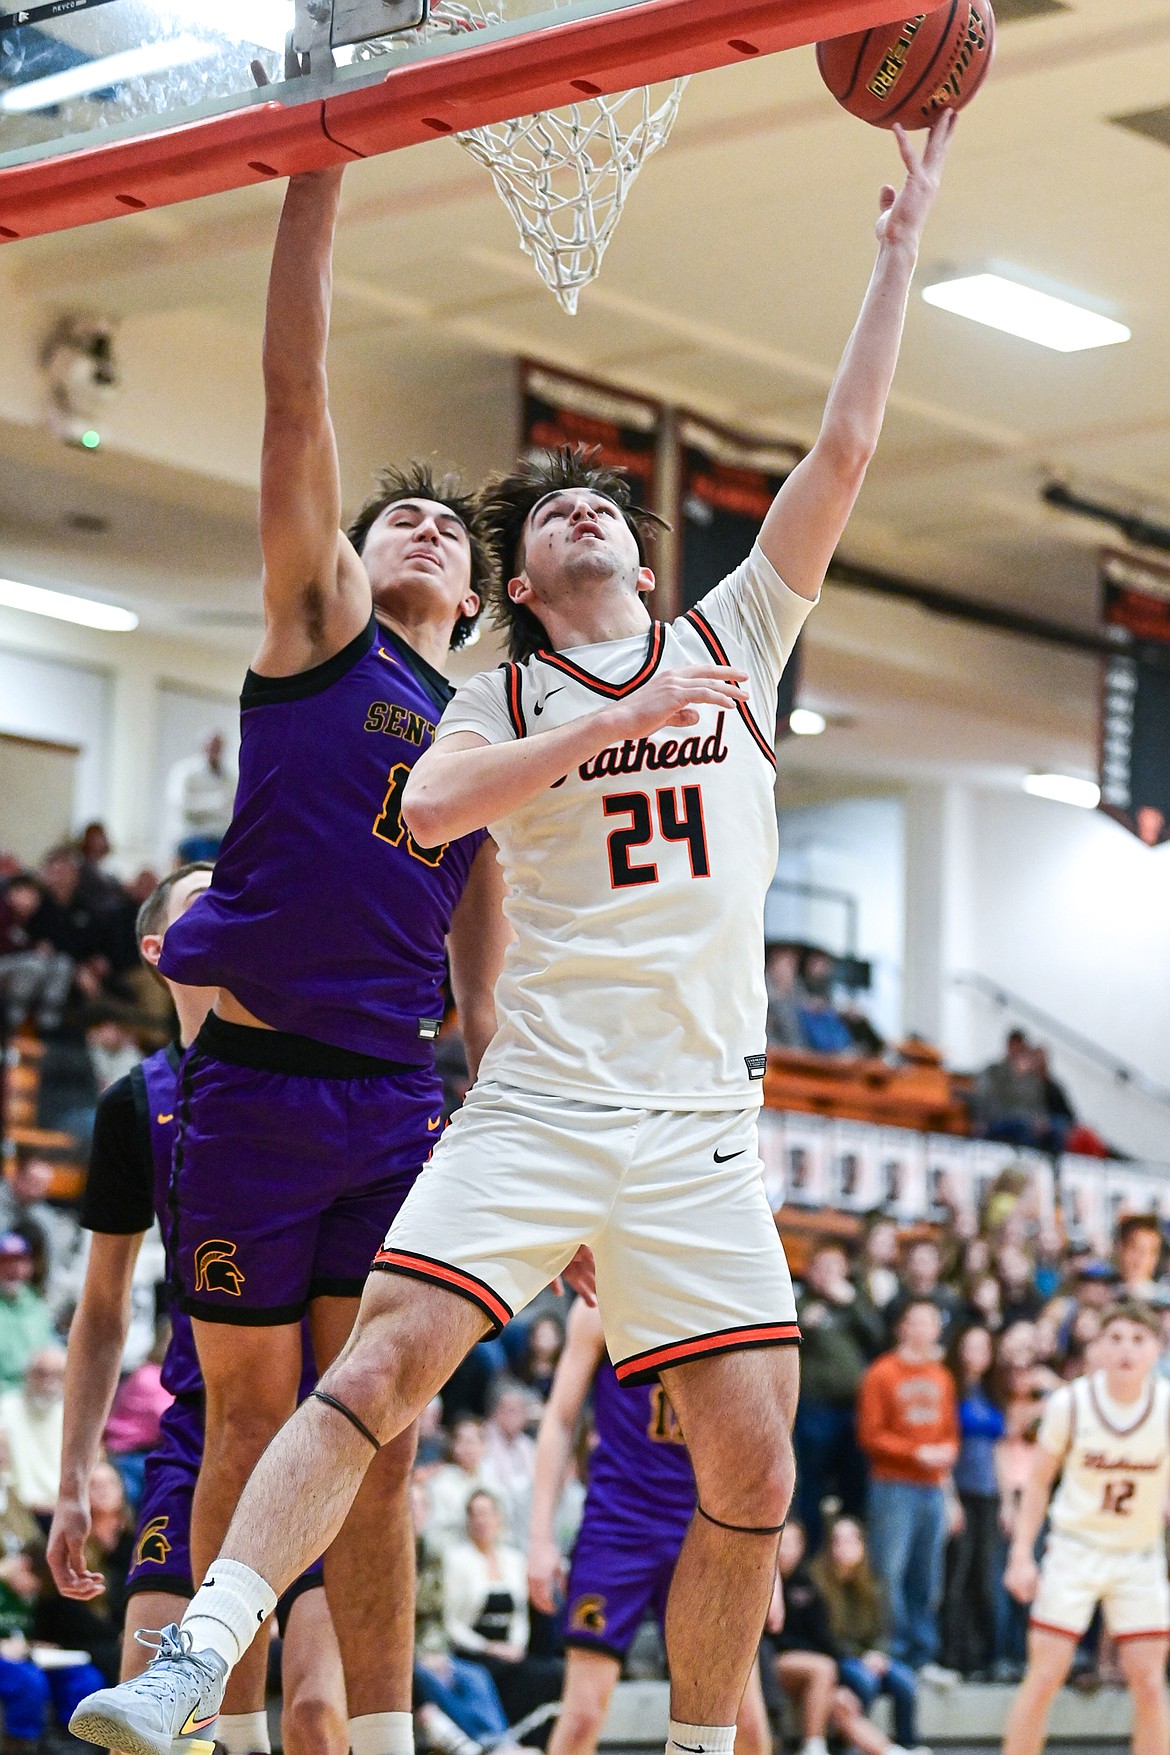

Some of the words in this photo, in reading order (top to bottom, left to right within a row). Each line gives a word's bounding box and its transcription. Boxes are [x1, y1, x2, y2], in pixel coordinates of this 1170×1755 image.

[550, 711, 728, 788] athead
[602, 784, 710, 889] 24
[1102, 1481, 1136, 1515] 12
